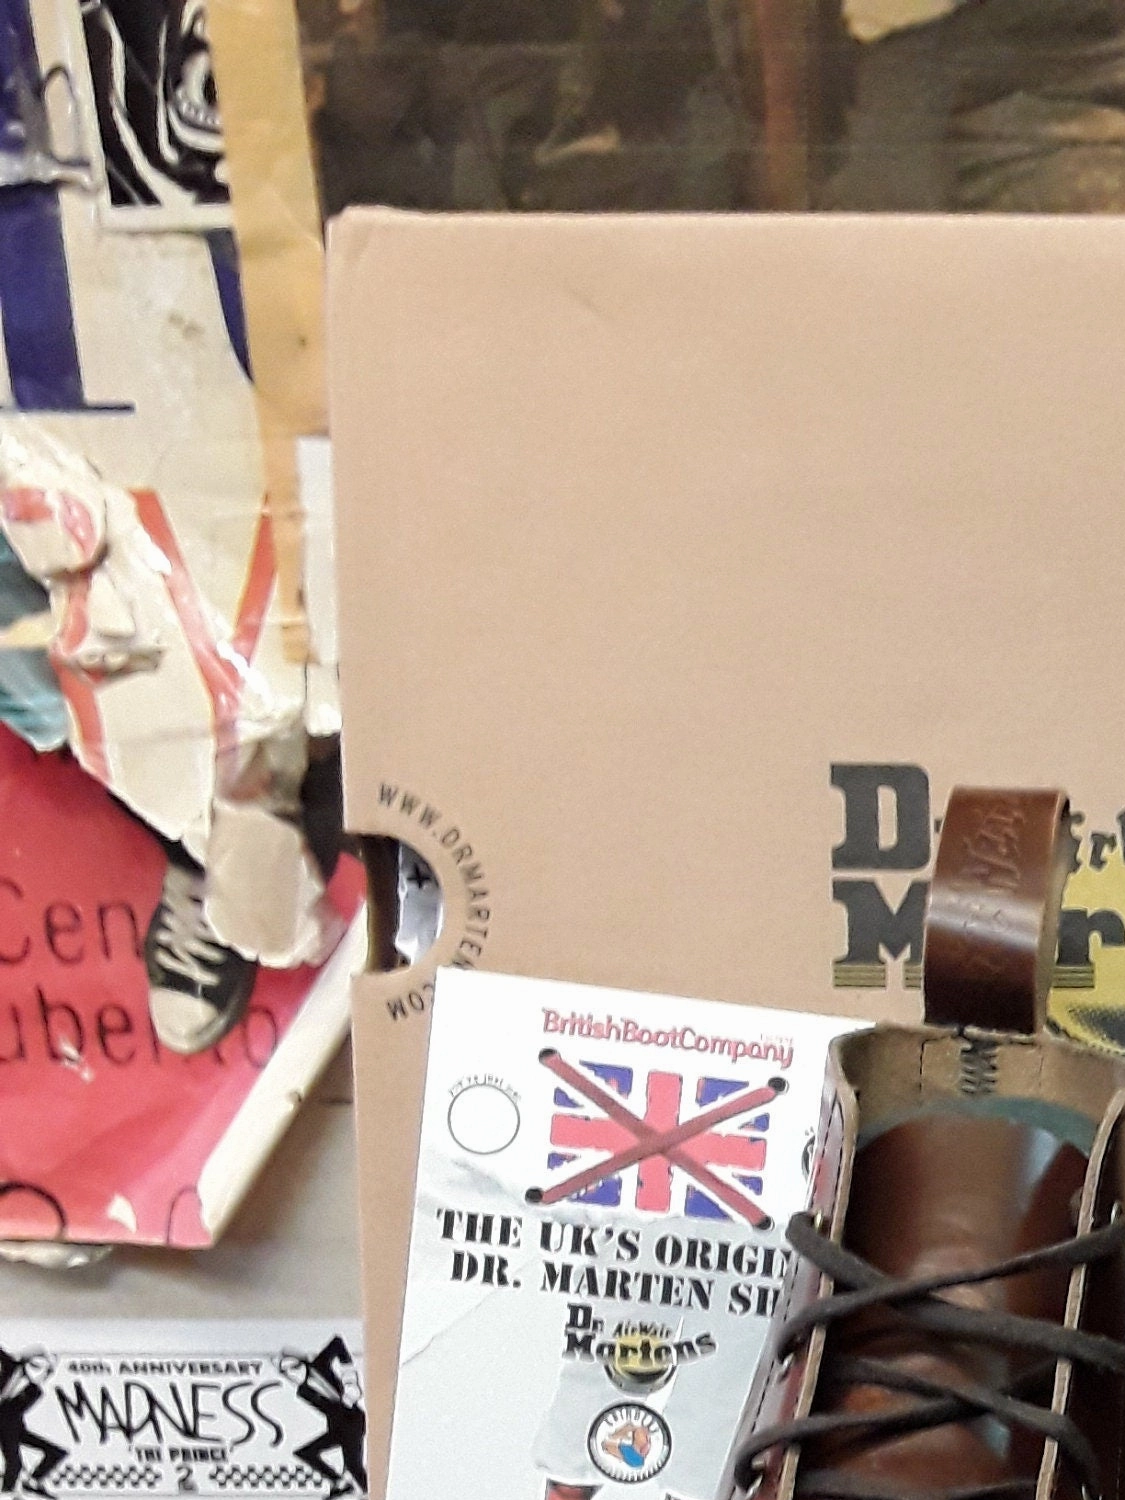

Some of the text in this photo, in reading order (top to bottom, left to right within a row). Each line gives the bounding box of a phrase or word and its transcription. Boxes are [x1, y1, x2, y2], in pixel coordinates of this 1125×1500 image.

[831, 762, 930, 870] D
[542, 1008, 795, 1067] BritishBootCompany
[437, 1209, 523, 1248] THE
[539, 1222, 641, 1262] UK'S
[450, 1250, 522, 1288] DR.
[541, 1261, 714, 1310] MARTEN
[119, 1360, 263, 1376] ANNIVERSARY
[562, 1331, 717, 1363] Martens
[55, 1381, 284, 1448] MADNESS
